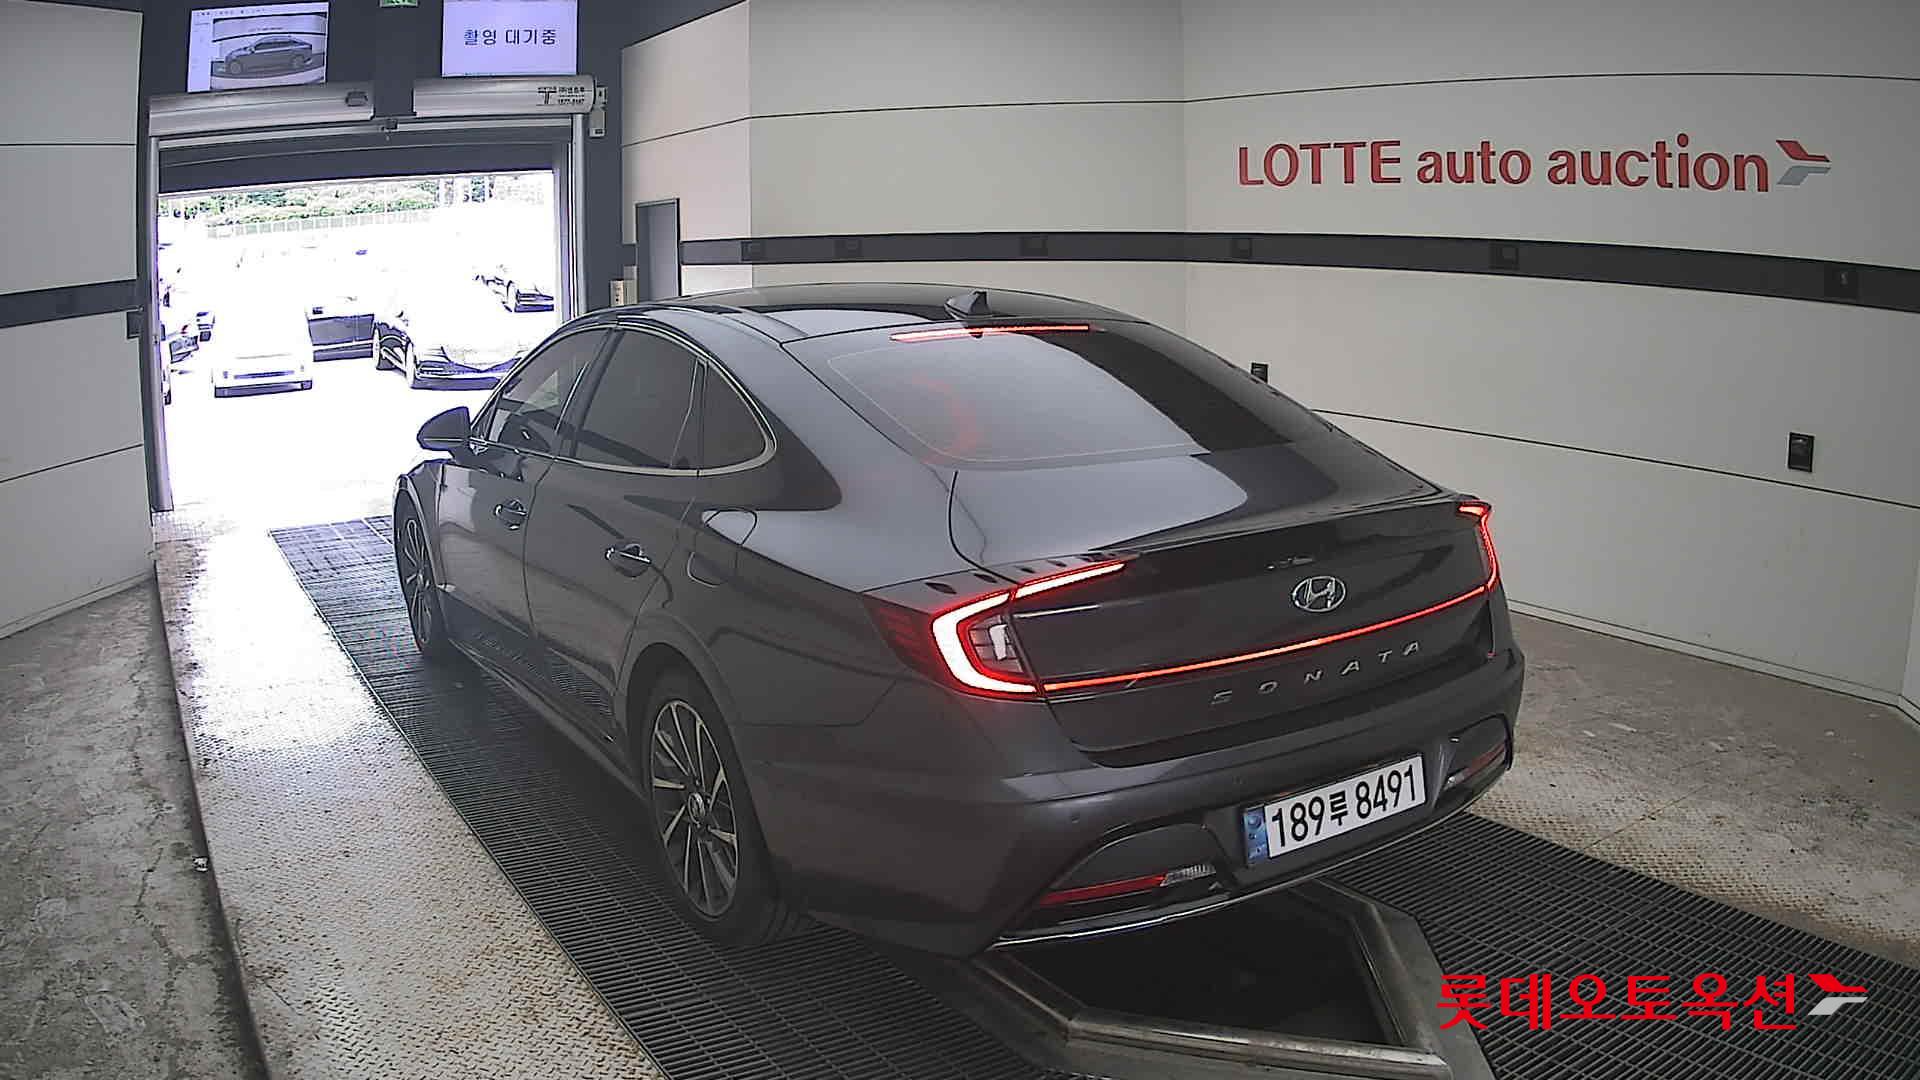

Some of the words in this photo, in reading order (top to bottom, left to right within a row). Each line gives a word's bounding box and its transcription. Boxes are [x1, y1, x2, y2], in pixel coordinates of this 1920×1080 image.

[464, 29, 497, 46] 촬영
[505, 29, 557, 46] 대기중
[1238, 140, 1401, 187] LOTTE
[1416, 140, 1531, 185] auto
[1547, 134, 1768, 192] auction
[1211, 641, 1420, 705] SONATA
[1271, 789, 1348, 847] 189루
[1355, 764, 1416, 820] 8491
